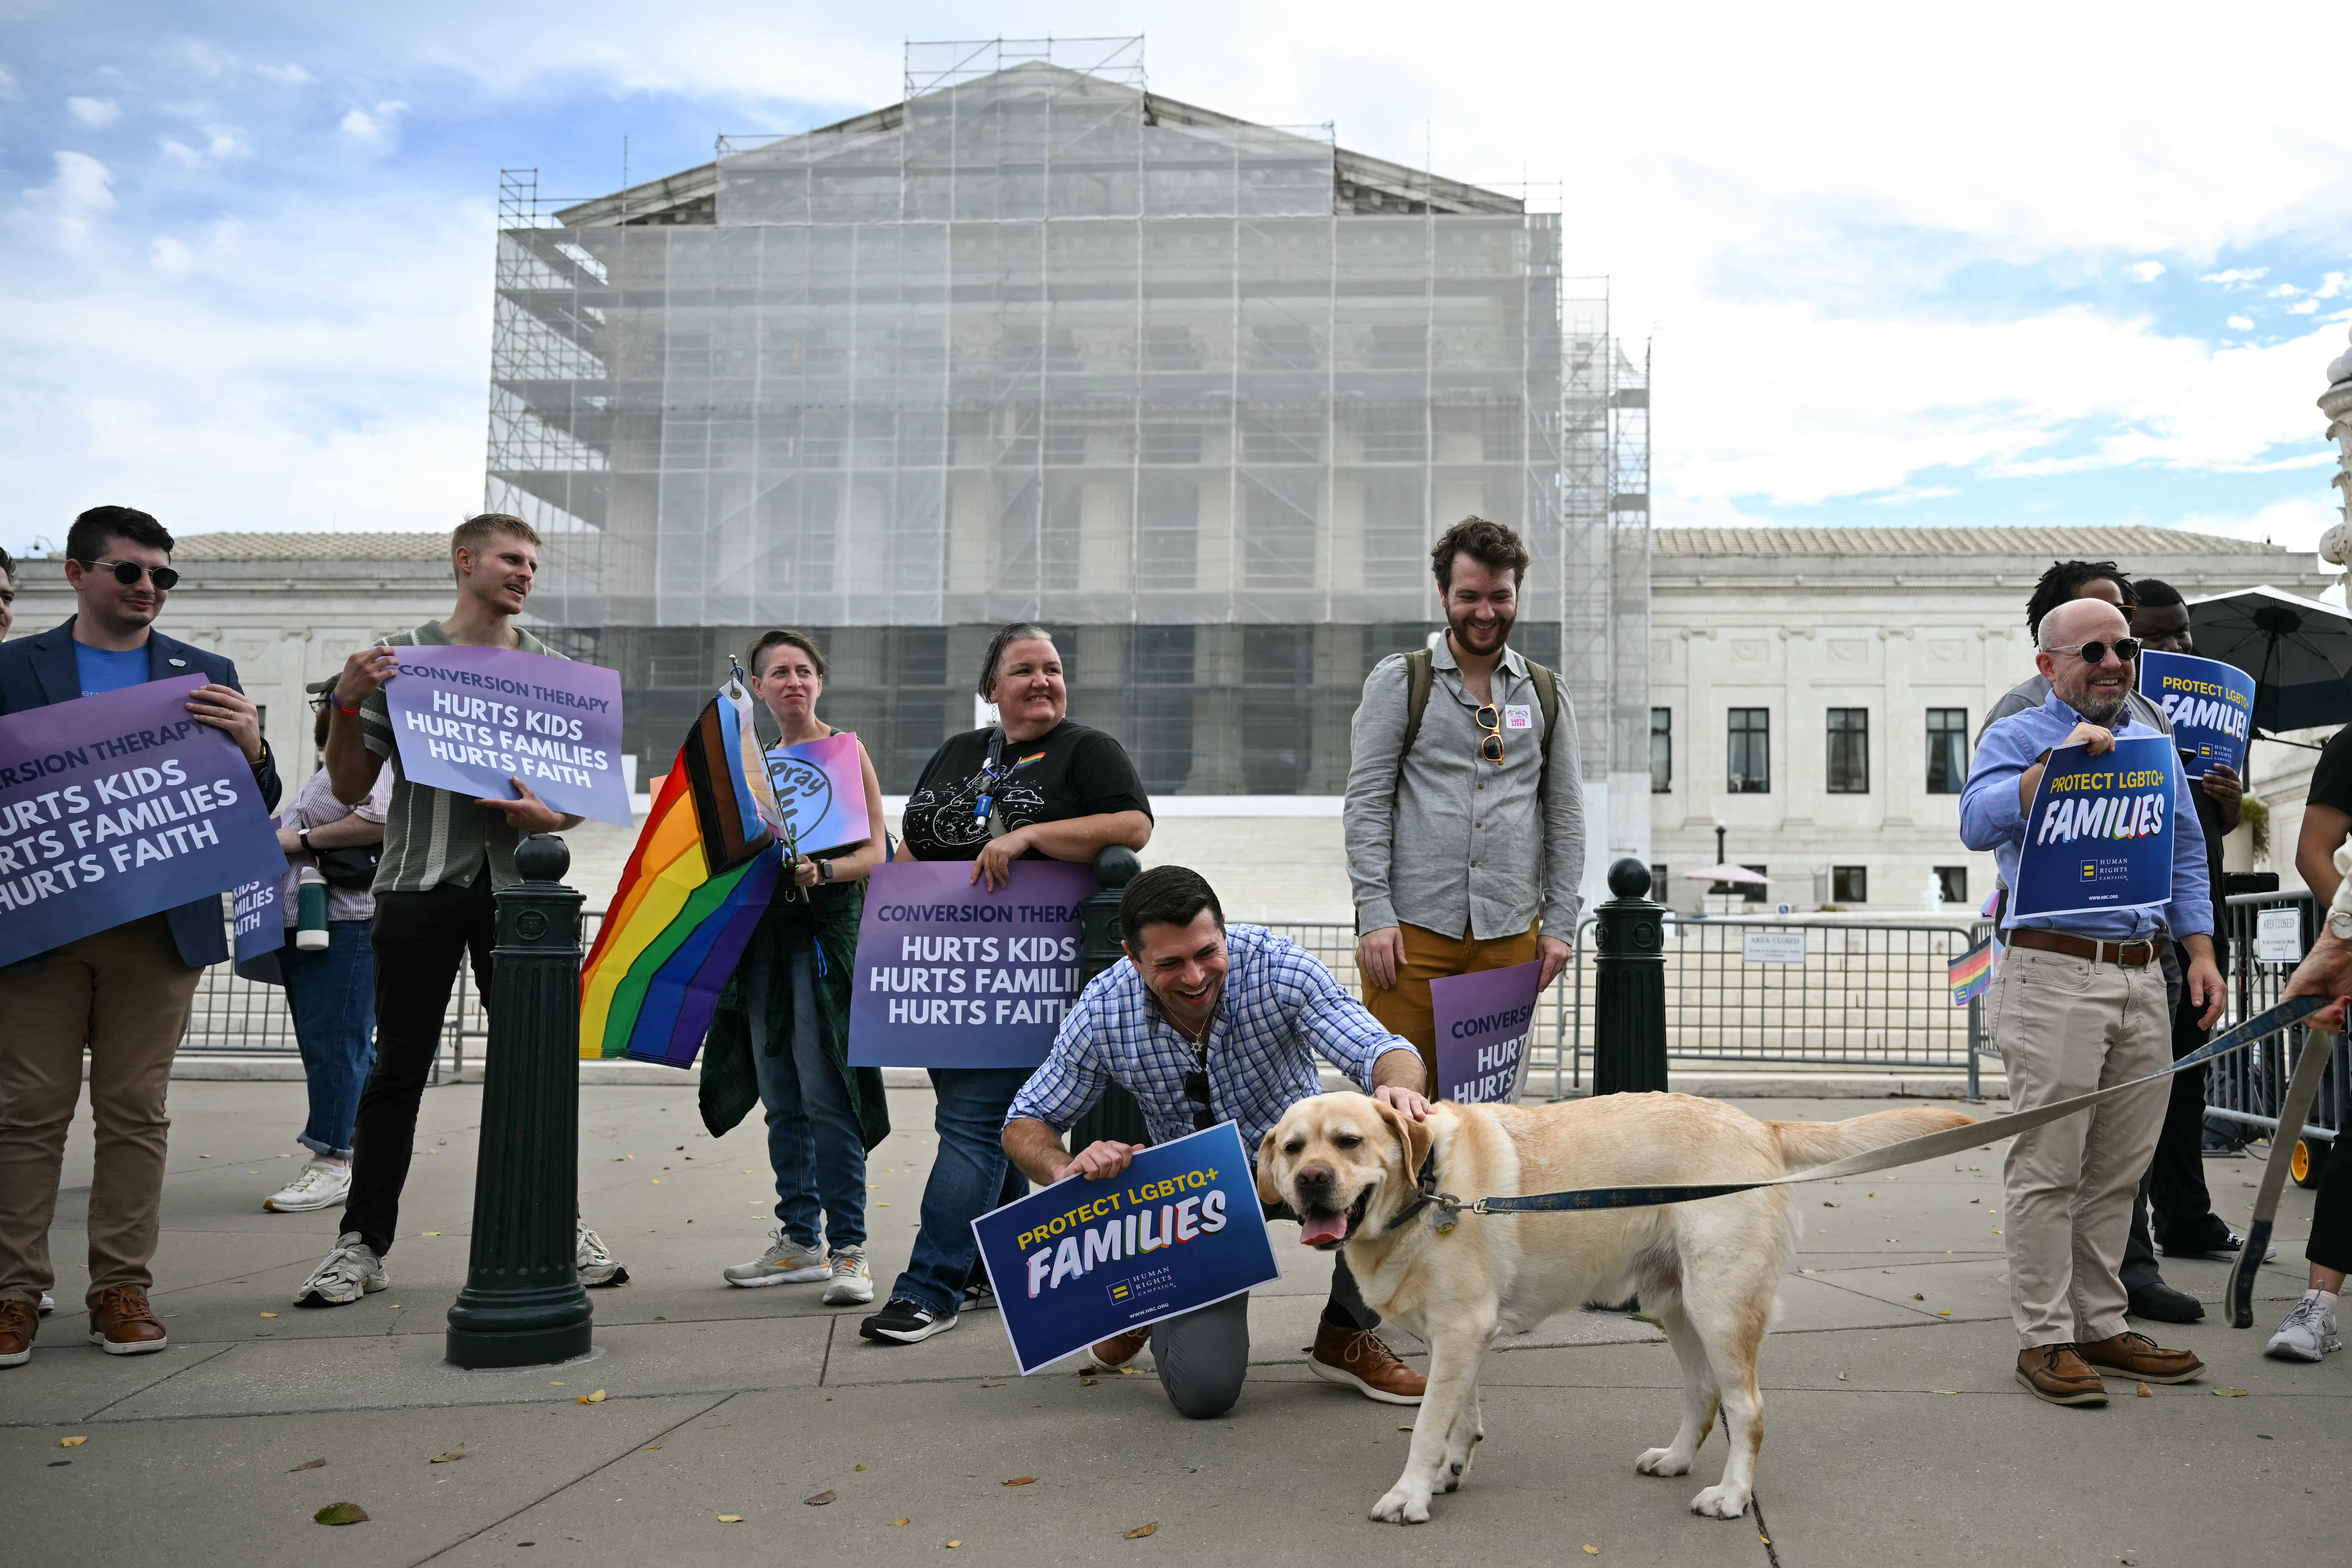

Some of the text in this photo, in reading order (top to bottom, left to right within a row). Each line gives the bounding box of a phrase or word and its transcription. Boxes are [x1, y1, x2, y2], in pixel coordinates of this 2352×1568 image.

[399, 665, 609, 714] CONVERSION THERAPY
[2163, 676, 2223, 697] PROTECT
[434, 690, 582, 741] HURTS KIDS
[2161, 694, 2246, 743] FAMILIES
[89, 719, 205, 762] THERAPY
[406, 710, 608, 770] HURTS FAMILIES
[94, 760, 187, 805] KIDS
[428, 739, 592, 788] HURTS FAITH
[2050, 770, 2164, 794] PROTECT LGBTQ+
[69, 779, 238, 848] FAMILIES
[2038, 793, 2165, 845] FAMILIES
[109, 819, 220, 873] FAITH
[234, 911, 260, 939] AITH
[878, 905, 1081, 923] CONVERSION THERA
[2263, 918, 2294, 929] AREA CLOSED
[902, 936, 1076, 962] HURTS KIDS
[871, 967, 967, 993] HURTS
[889, 999, 1078, 1025] HURTS FAITH
[1454, 1065, 1515, 1105] HURTS
[1017, 1167, 1219, 1250] PROTECT LGBTQ+
[1027, 1190, 1227, 1297] FAMILIES
[1133, 1267, 1170, 1282] HUMAN
[1135, 1275, 1172, 1290] RIGHTS
[1138, 1282, 1174, 1296] CAMPAIGN
[1129, 1303, 1169, 1319] WWW.HRC.ORG
